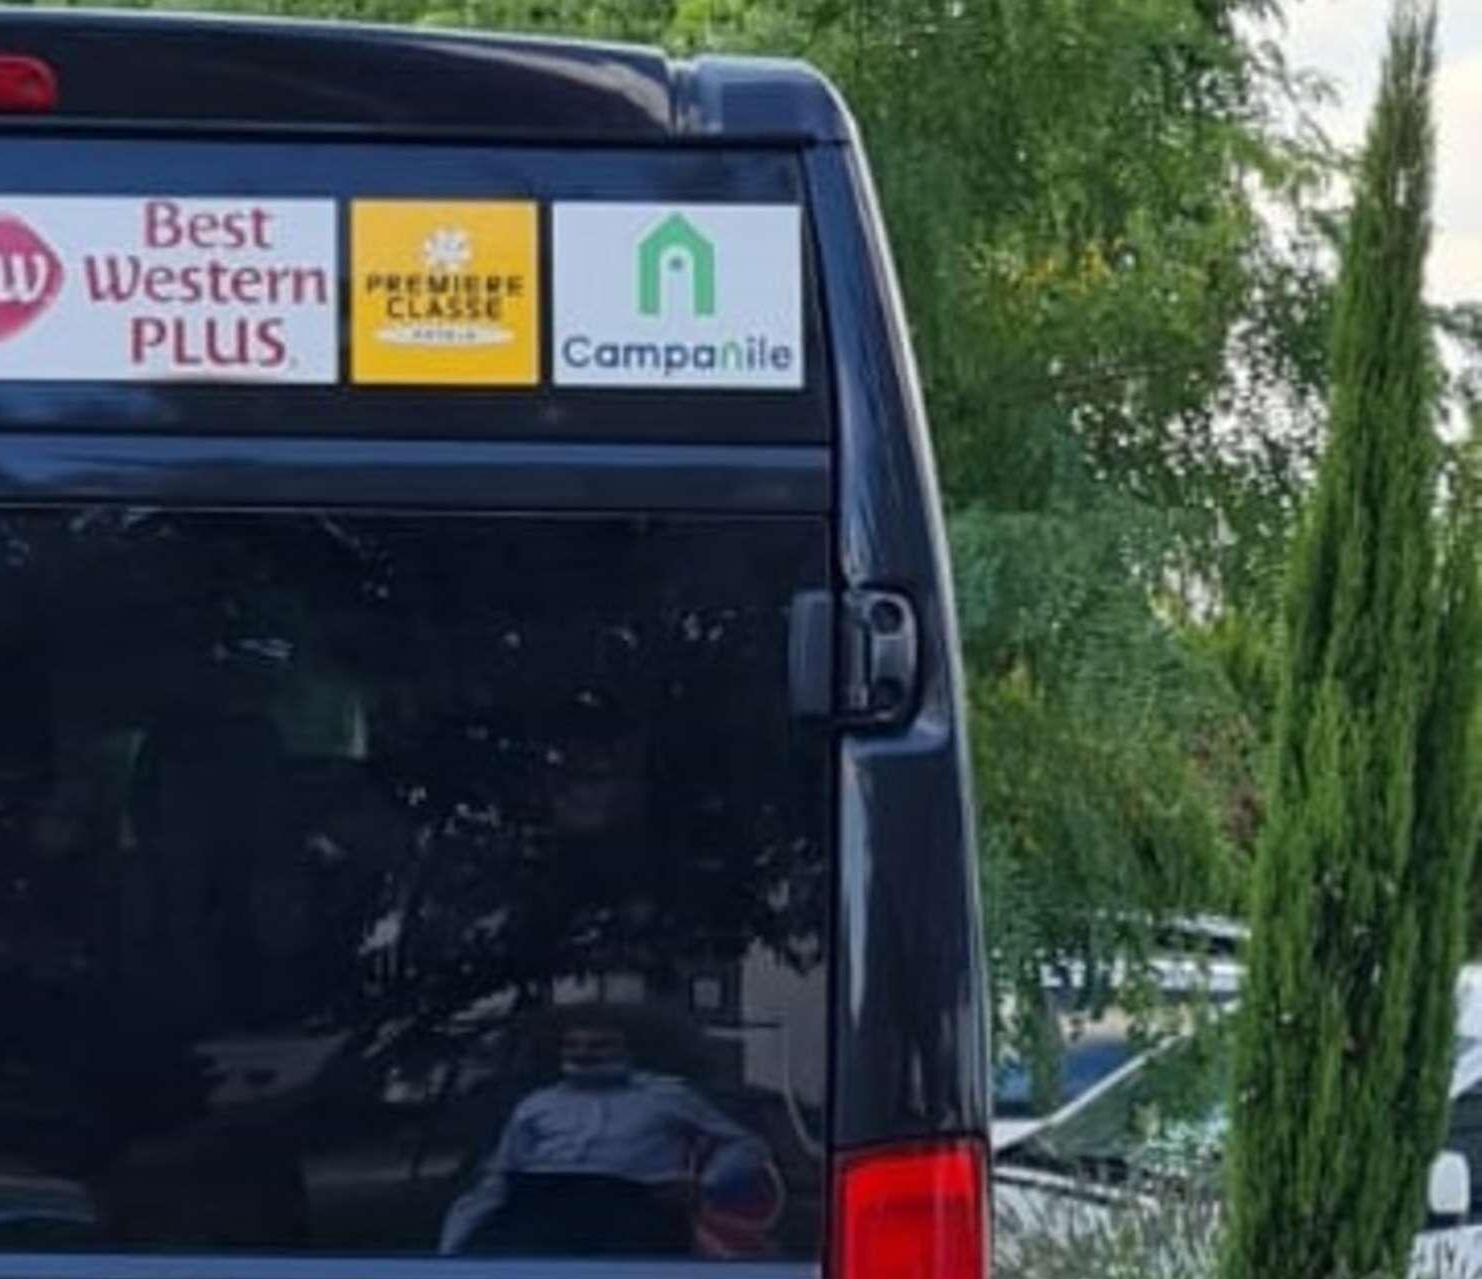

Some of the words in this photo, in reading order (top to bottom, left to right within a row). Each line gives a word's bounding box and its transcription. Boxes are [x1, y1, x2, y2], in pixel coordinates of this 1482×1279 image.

[143, 200, 274, 249] Best
[83, 255, 329, 306] Western
[385, 295, 503, 320] CLASSE
[129, 316, 287, 368] PLUS
[561, 335, 794, 376] Campanile
